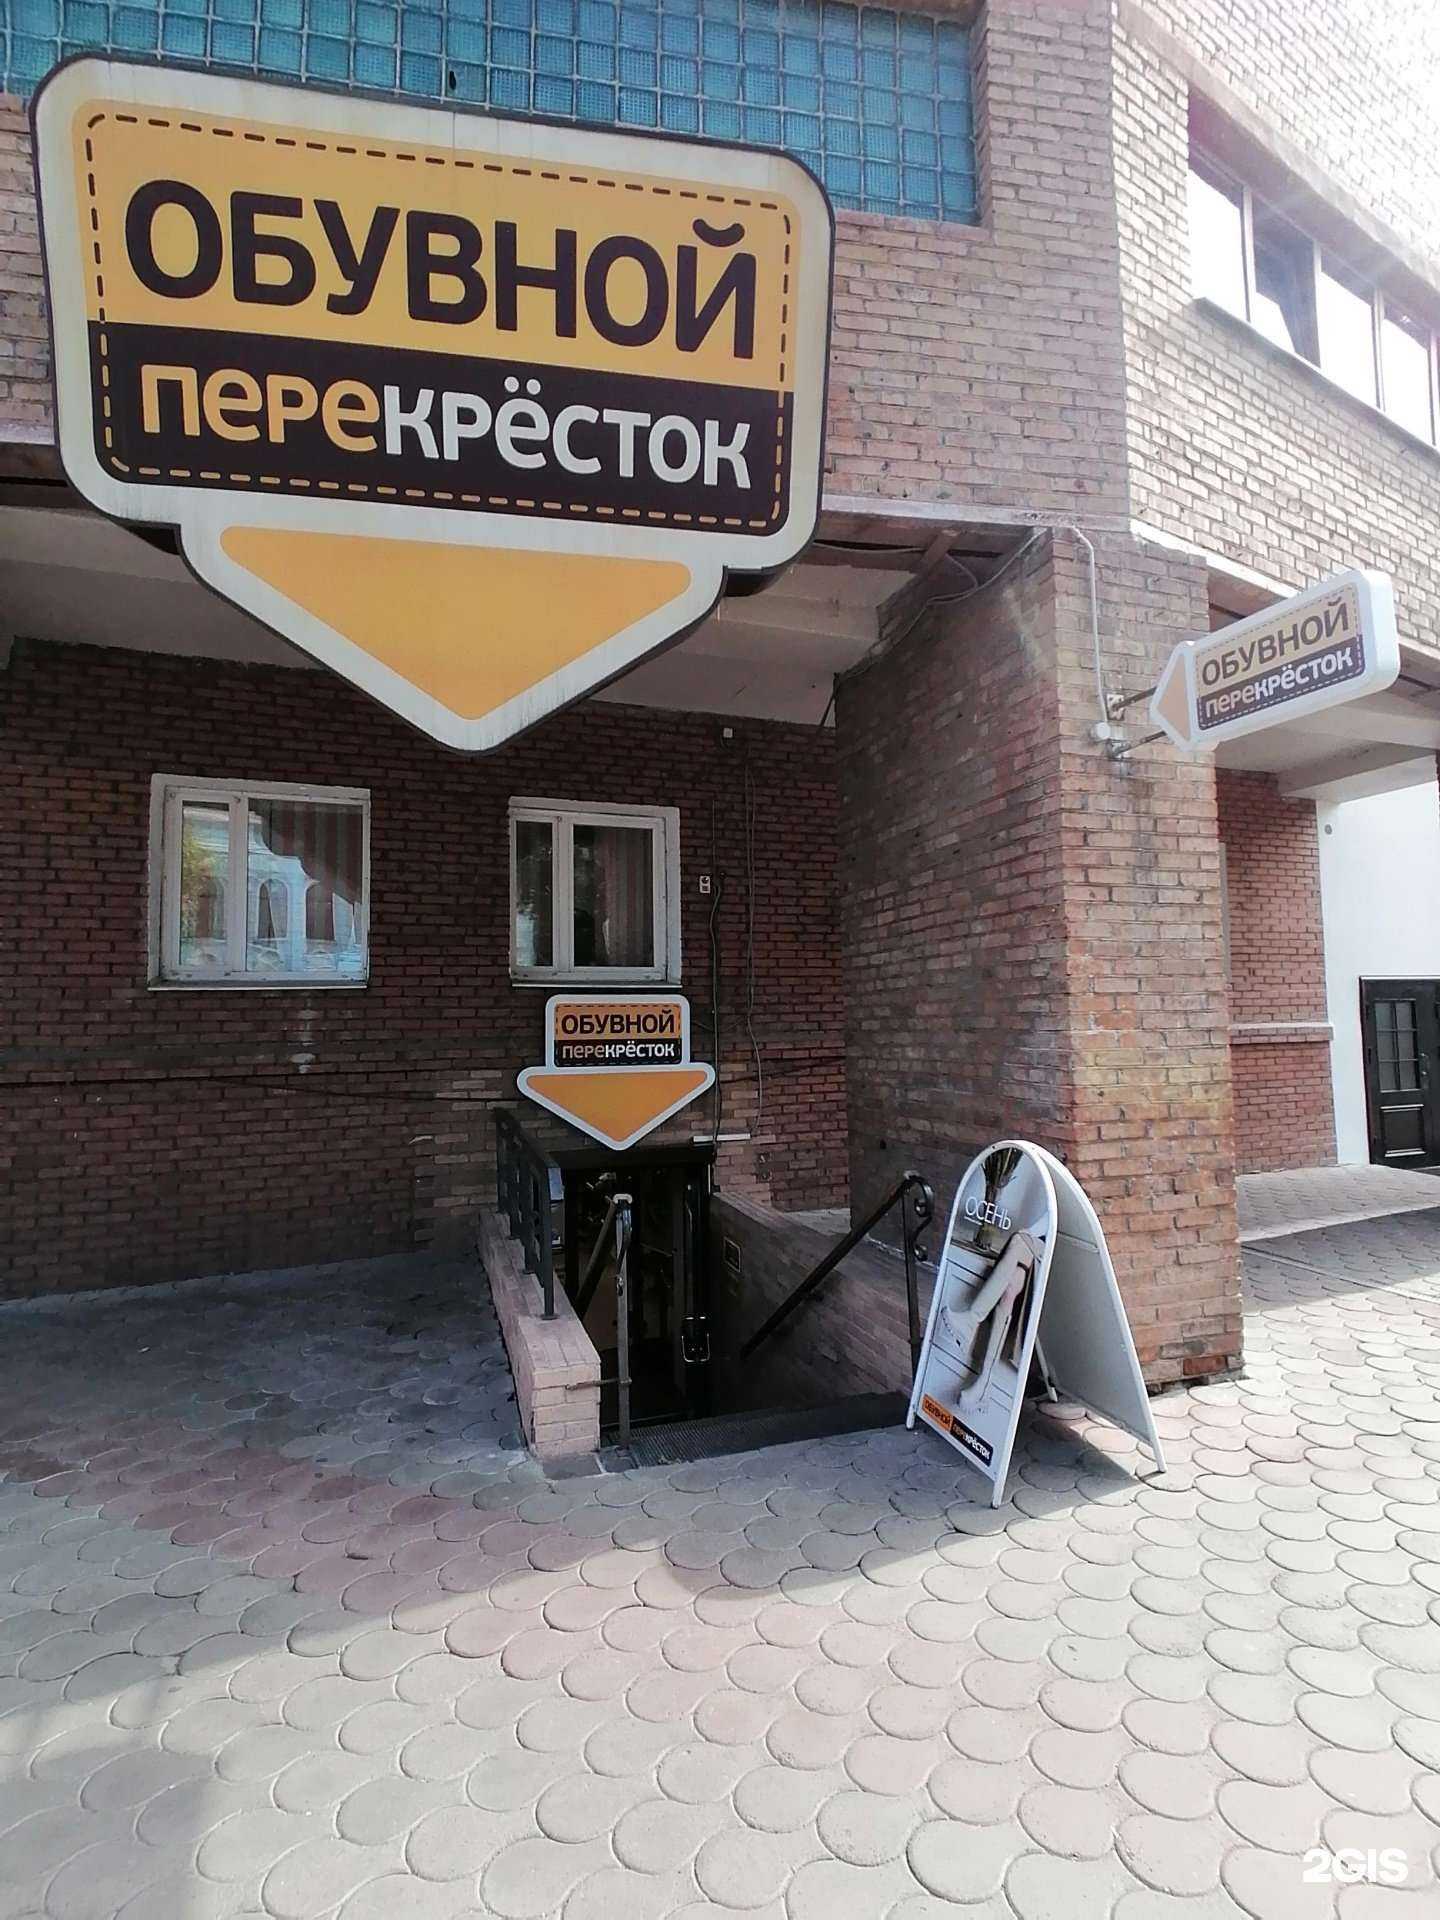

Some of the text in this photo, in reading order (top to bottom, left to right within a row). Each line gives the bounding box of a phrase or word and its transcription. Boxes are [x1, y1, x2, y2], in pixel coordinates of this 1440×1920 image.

[125, 179, 756, 359] ОБУВНОЙ
[1202, 597, 1349, 686] ОБУВНОЙ
[561, 1009, 675, 1034] ОБУВНОЙ
[965, 1196, 1011, 1230] ОСЕНЬ
